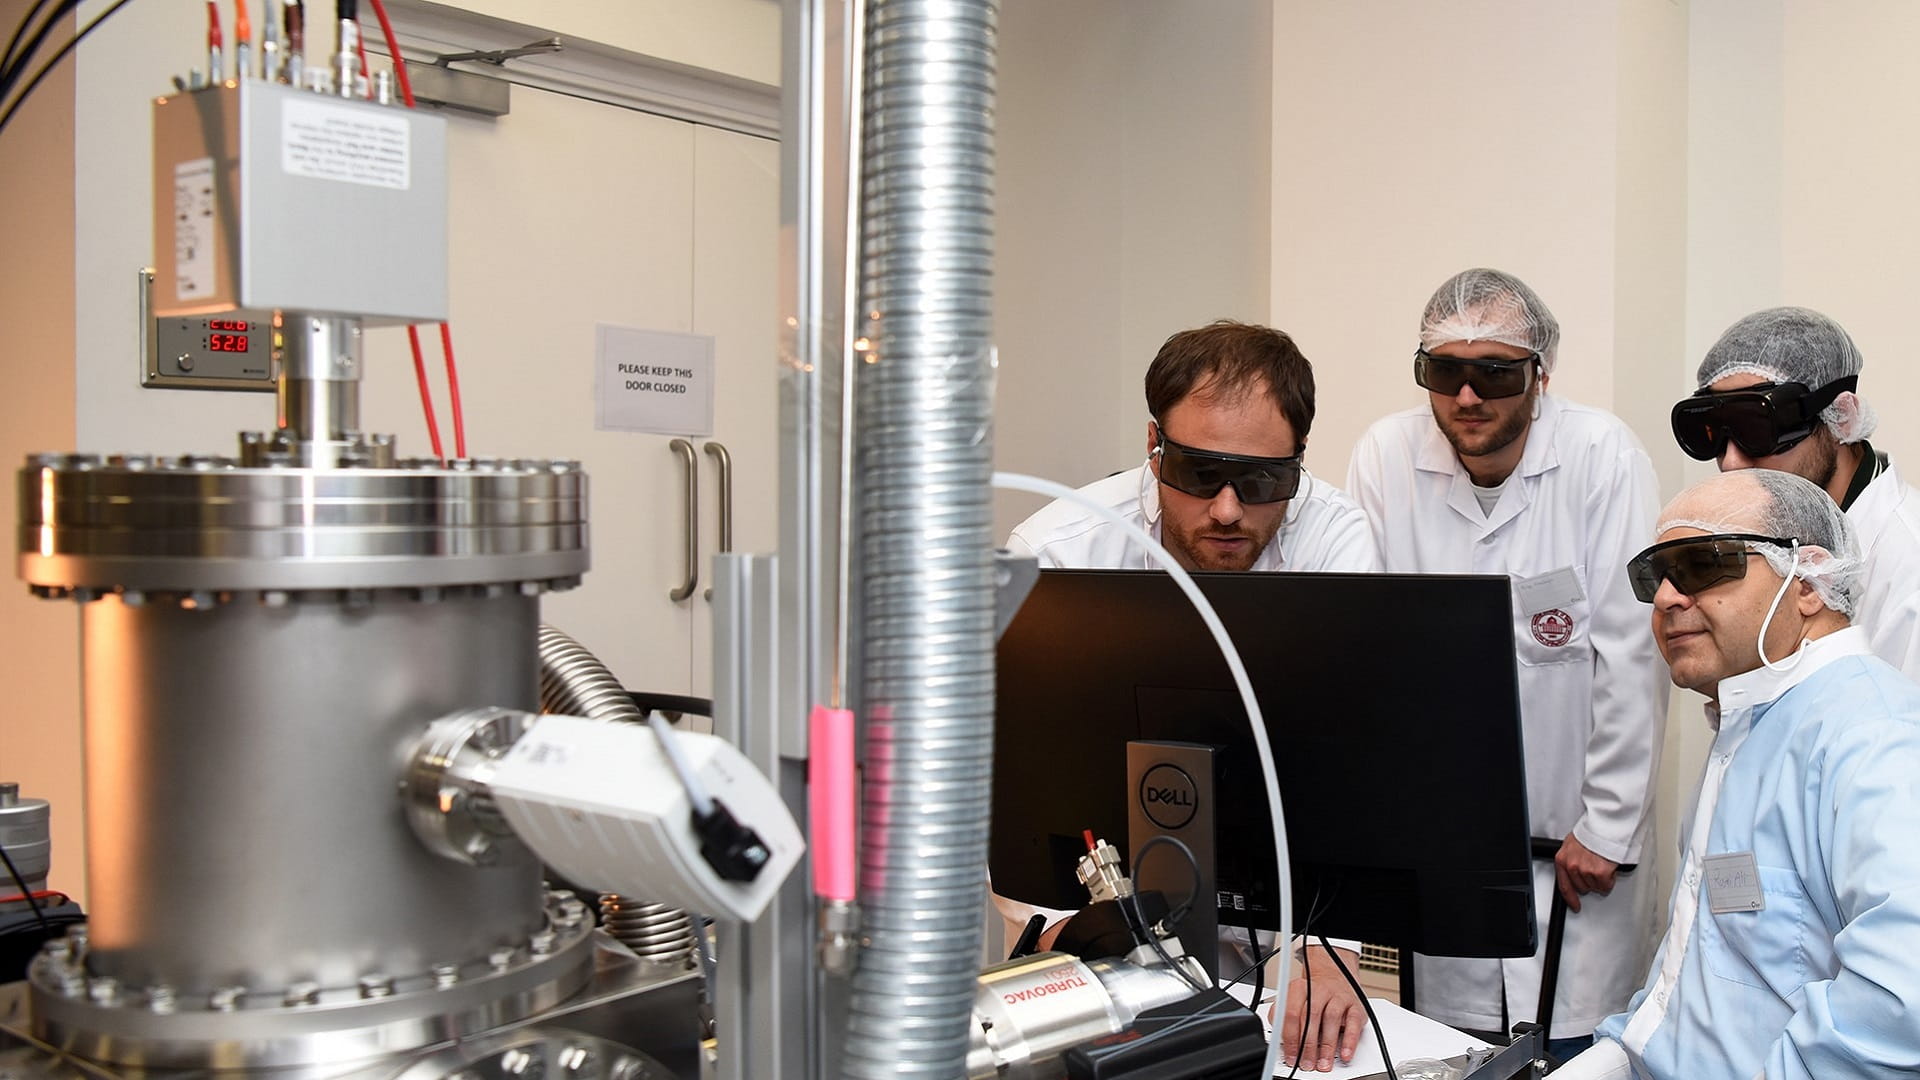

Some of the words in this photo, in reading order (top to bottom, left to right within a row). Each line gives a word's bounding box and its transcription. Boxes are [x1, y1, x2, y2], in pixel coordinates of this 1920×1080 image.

[211, 334, 247, 351] 52.8
[618, 363, 650, 375] PLEASE
[651, 366, 672, 376] KEEP
[675, 368, 693, 378] THIS
[625, 380, 652, 391] DOOR
[653, 382, 686, 394] CLOSED
[1147, 787, 1193, 806] DELL
[1004, 977, 1087, 1005] TURBOVAC
